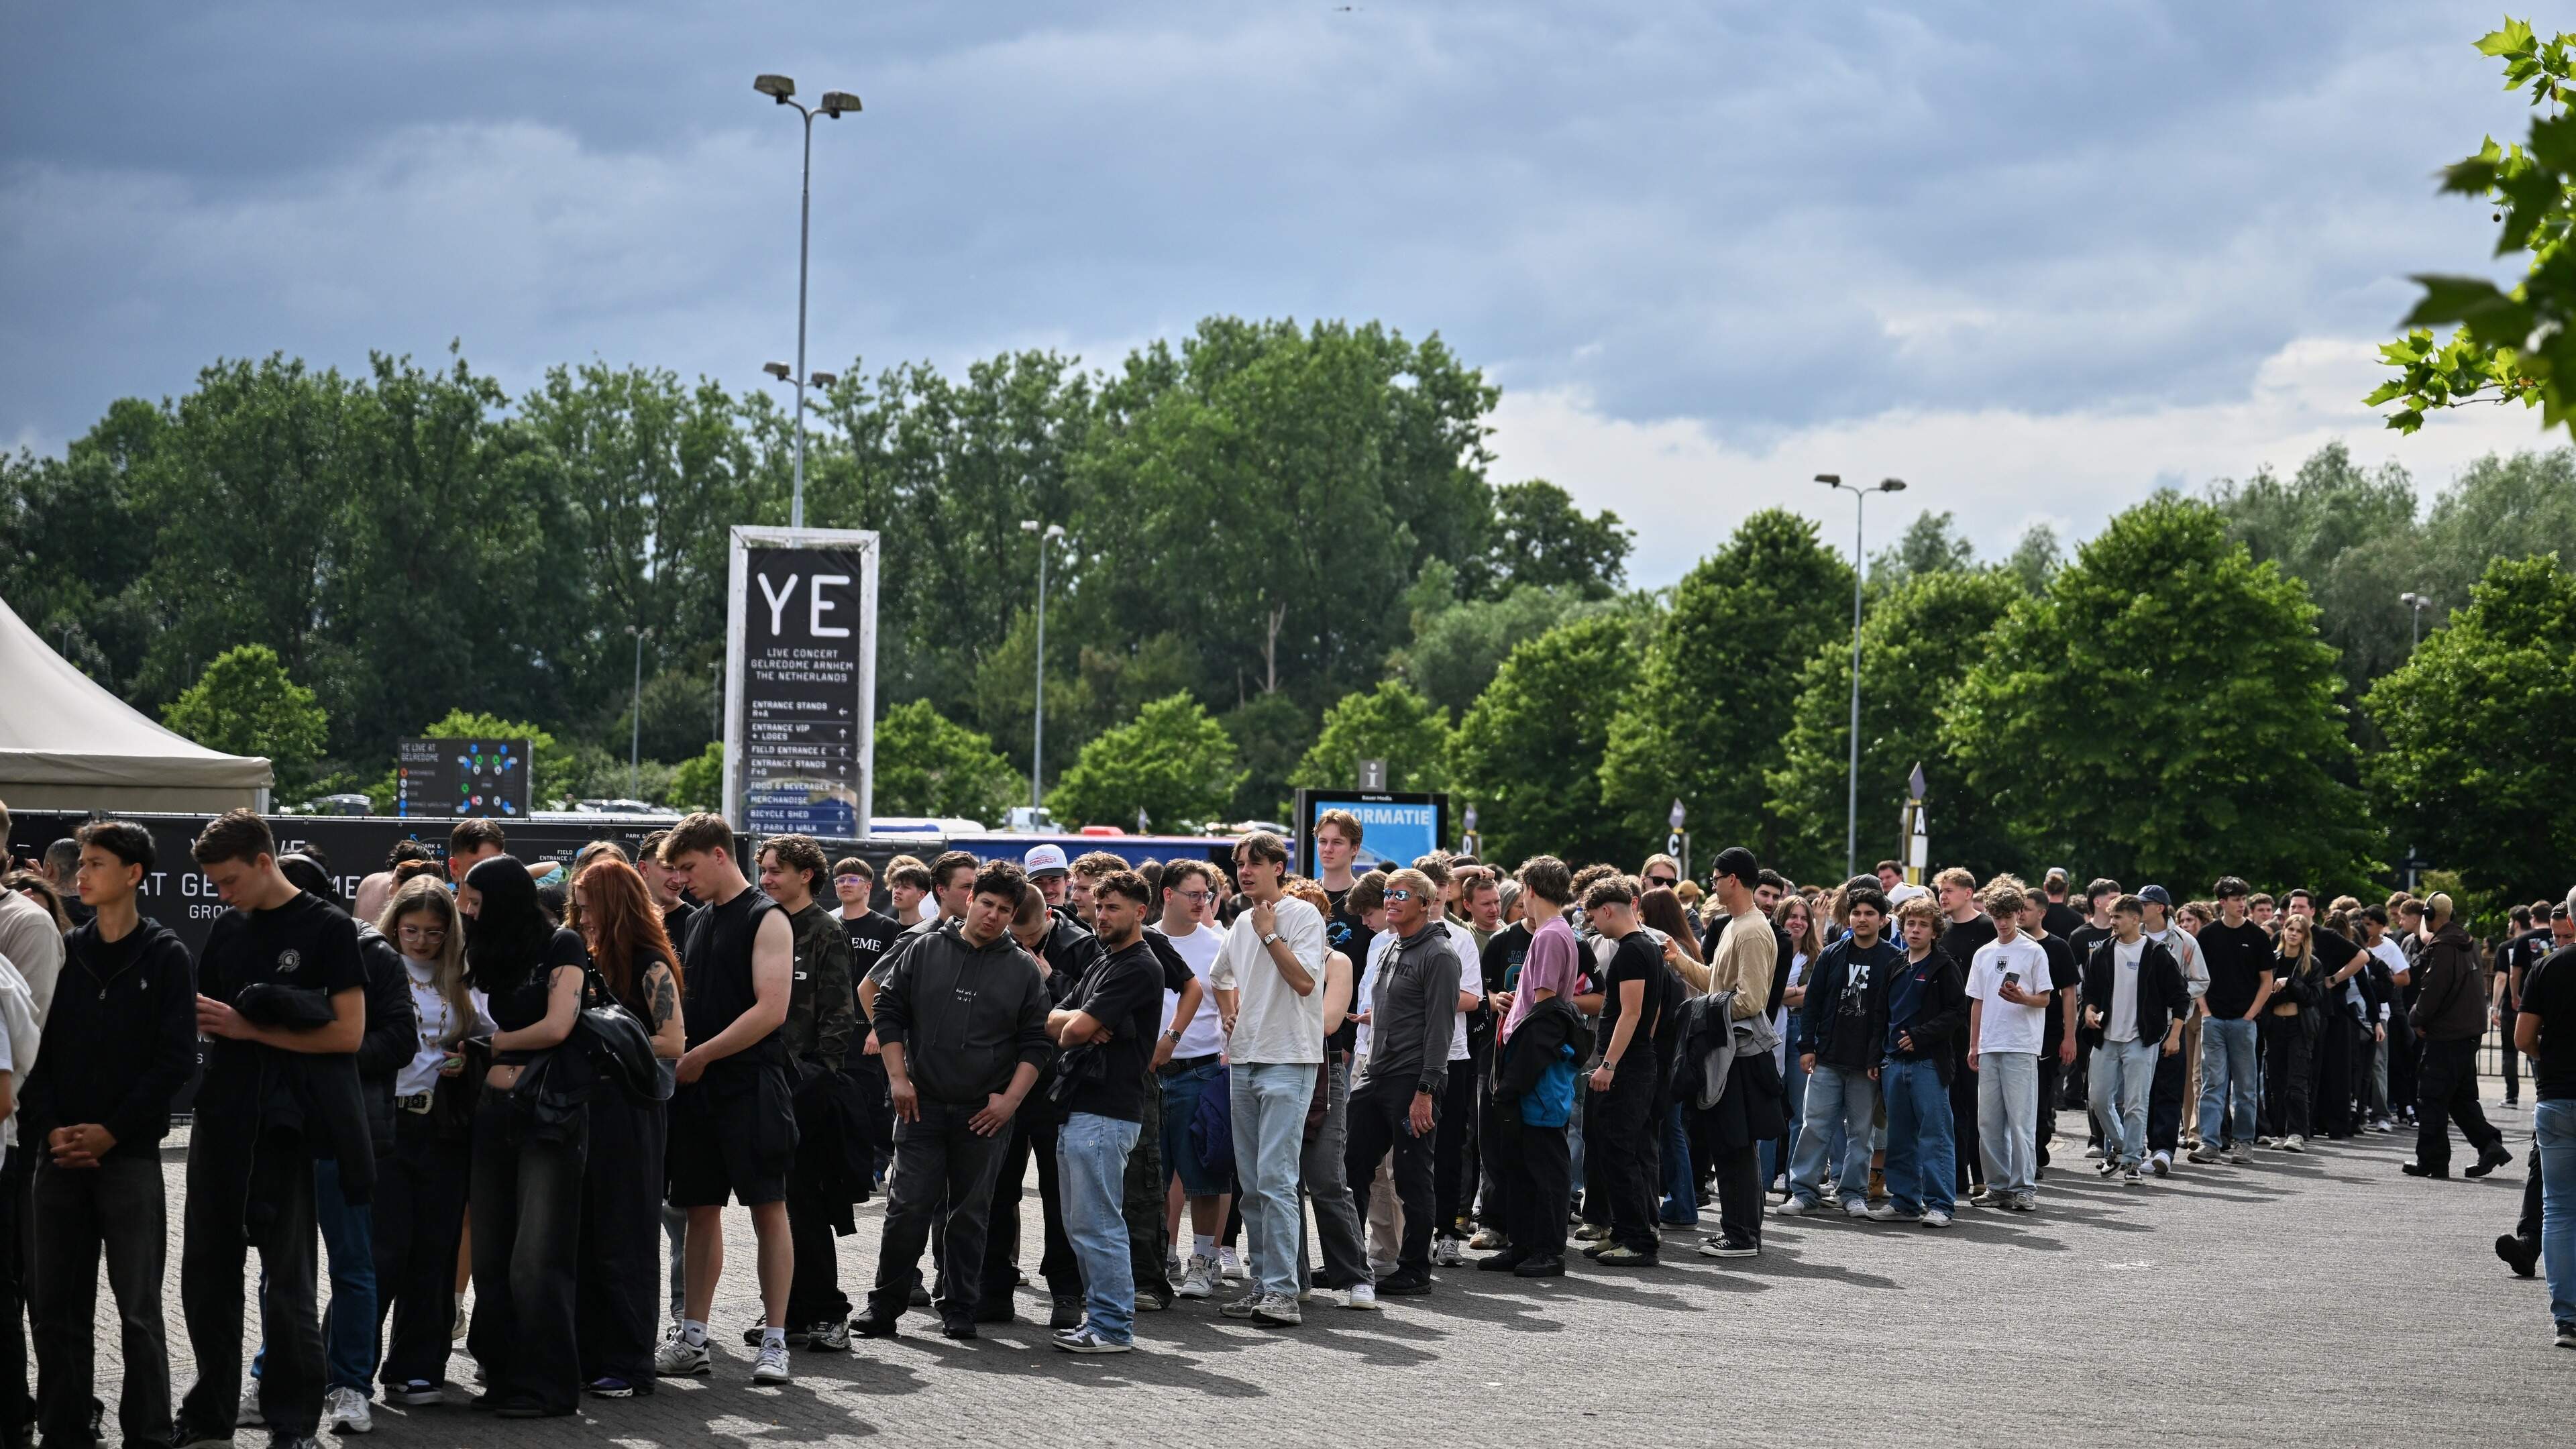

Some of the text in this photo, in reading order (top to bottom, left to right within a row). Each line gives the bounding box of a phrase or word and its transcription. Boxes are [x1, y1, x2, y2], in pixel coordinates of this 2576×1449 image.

[757, 573, 850, 637] YE
[767, 648, 838, 659] LIVE CONCERT
[751, 659, 853, 671] GELREDOME ARNHEM
[756, 671, 847, 682] THE NETHERLANDS
[752, 700, 828, 710] ENTRANCE STANDS
[751, 723, 810, 733] ENTRANCE VIP
[761, 732, 788, 741] LOGES
[751, 745, 827, 755] FIELD ENTRANCE E
[751, 759, 826, 769] ENTRANCE STANDS
[751, 782, 772, 791] FOOD
[783, 782, 830, 792] BEVERAGES
[750, 794, 808, 804] MERCHANDISE
[750, 810, 809, 819] BICYCLE SHED
[1322, 807, 1430, 825] ORMATIE
[1914, 806, 1926, 834] A
[750, 822, 761, 832] P2
[763, 823, 786, 833] PARK
[796, 824, 817, 833] WALK
[1668, 834, 1680, 856] C
